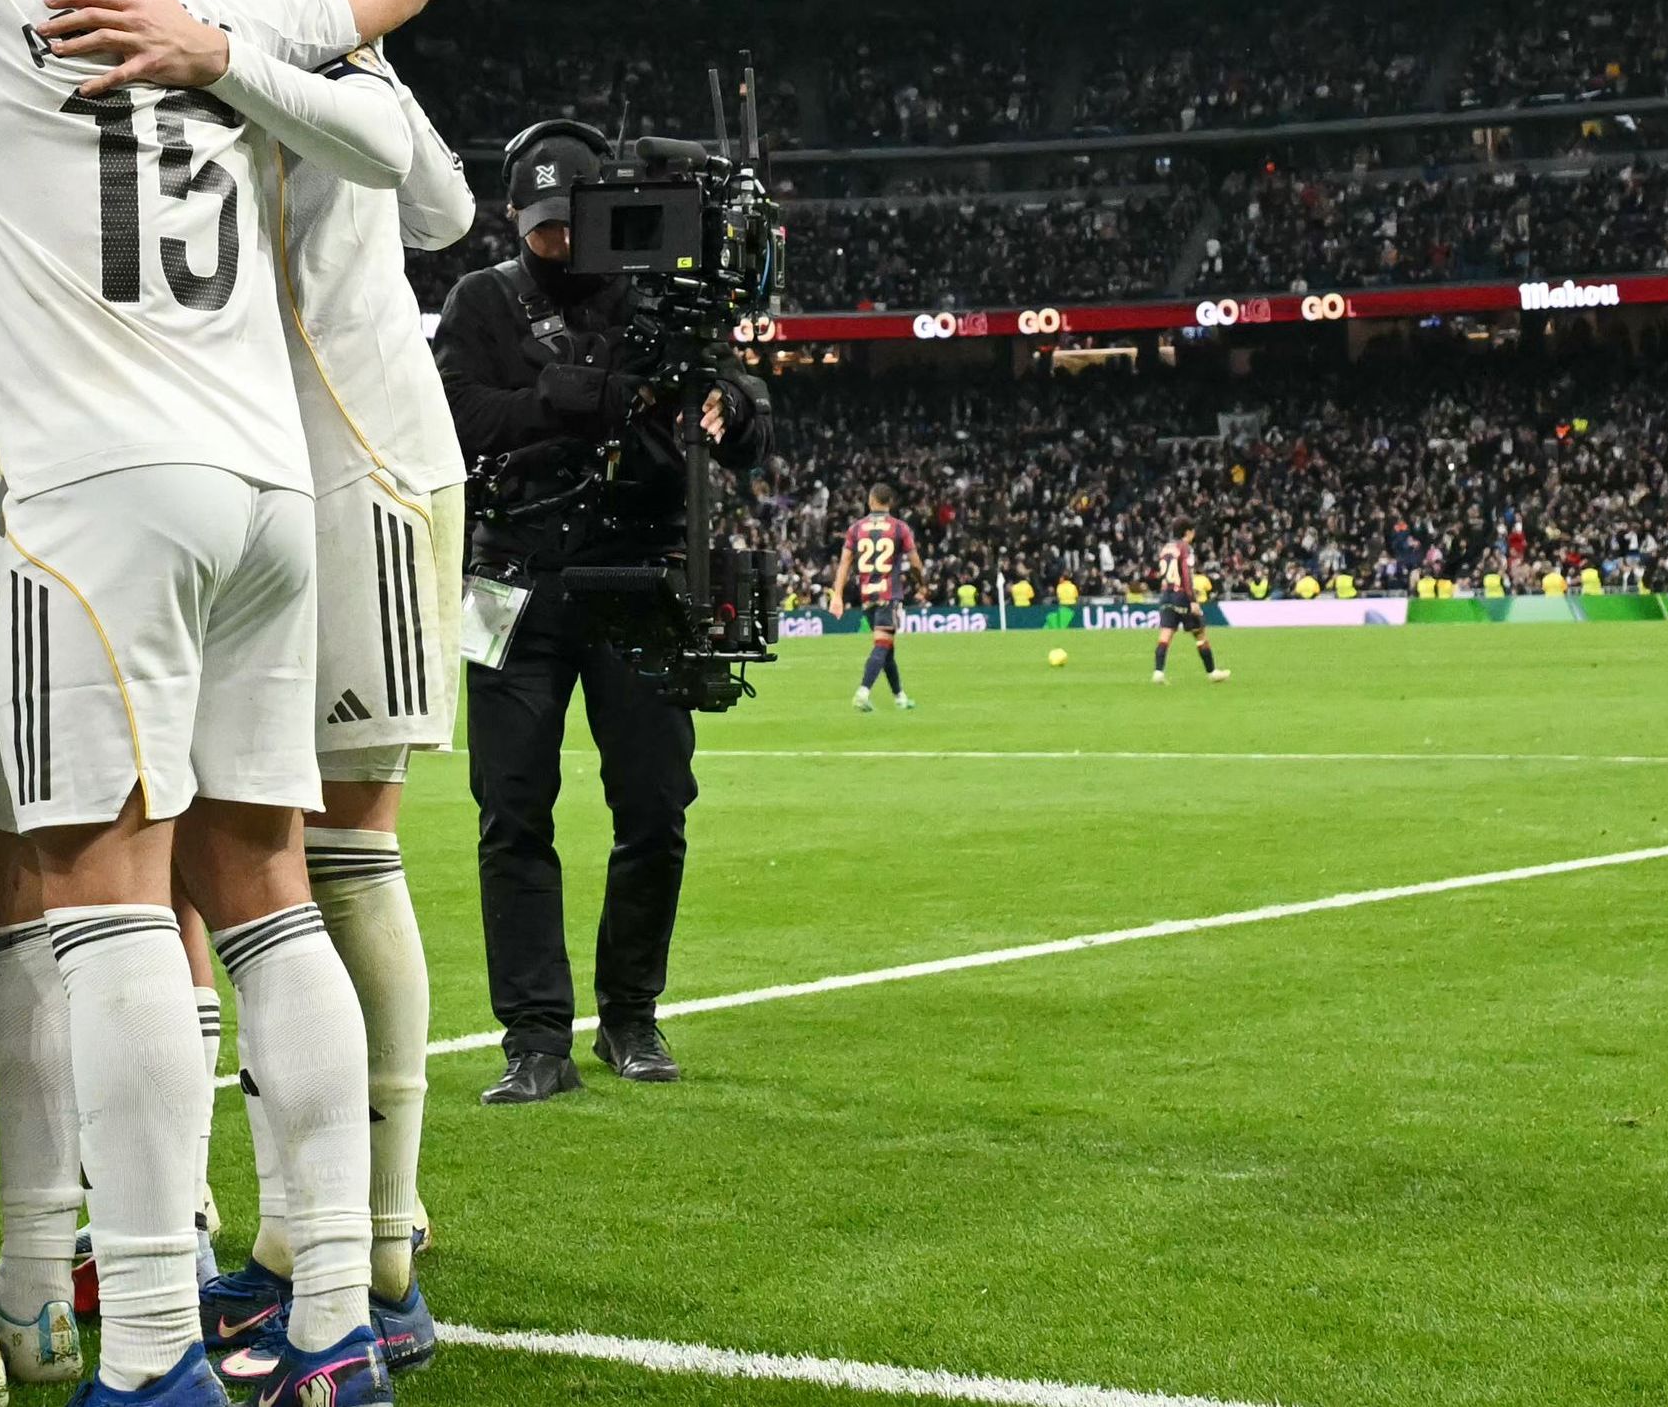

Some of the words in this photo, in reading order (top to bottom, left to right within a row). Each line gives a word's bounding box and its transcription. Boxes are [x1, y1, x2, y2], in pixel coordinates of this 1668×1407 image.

[60, 87, 245, 311] 15
[1301, 292, 1357, 321] GOL
[1518, 280, 1620, 310] Mahou
[1017, 308, 1072, 335] GOL
[857, 537, 895, 573] 22
[1082, 607, 1161, 630] Unica
